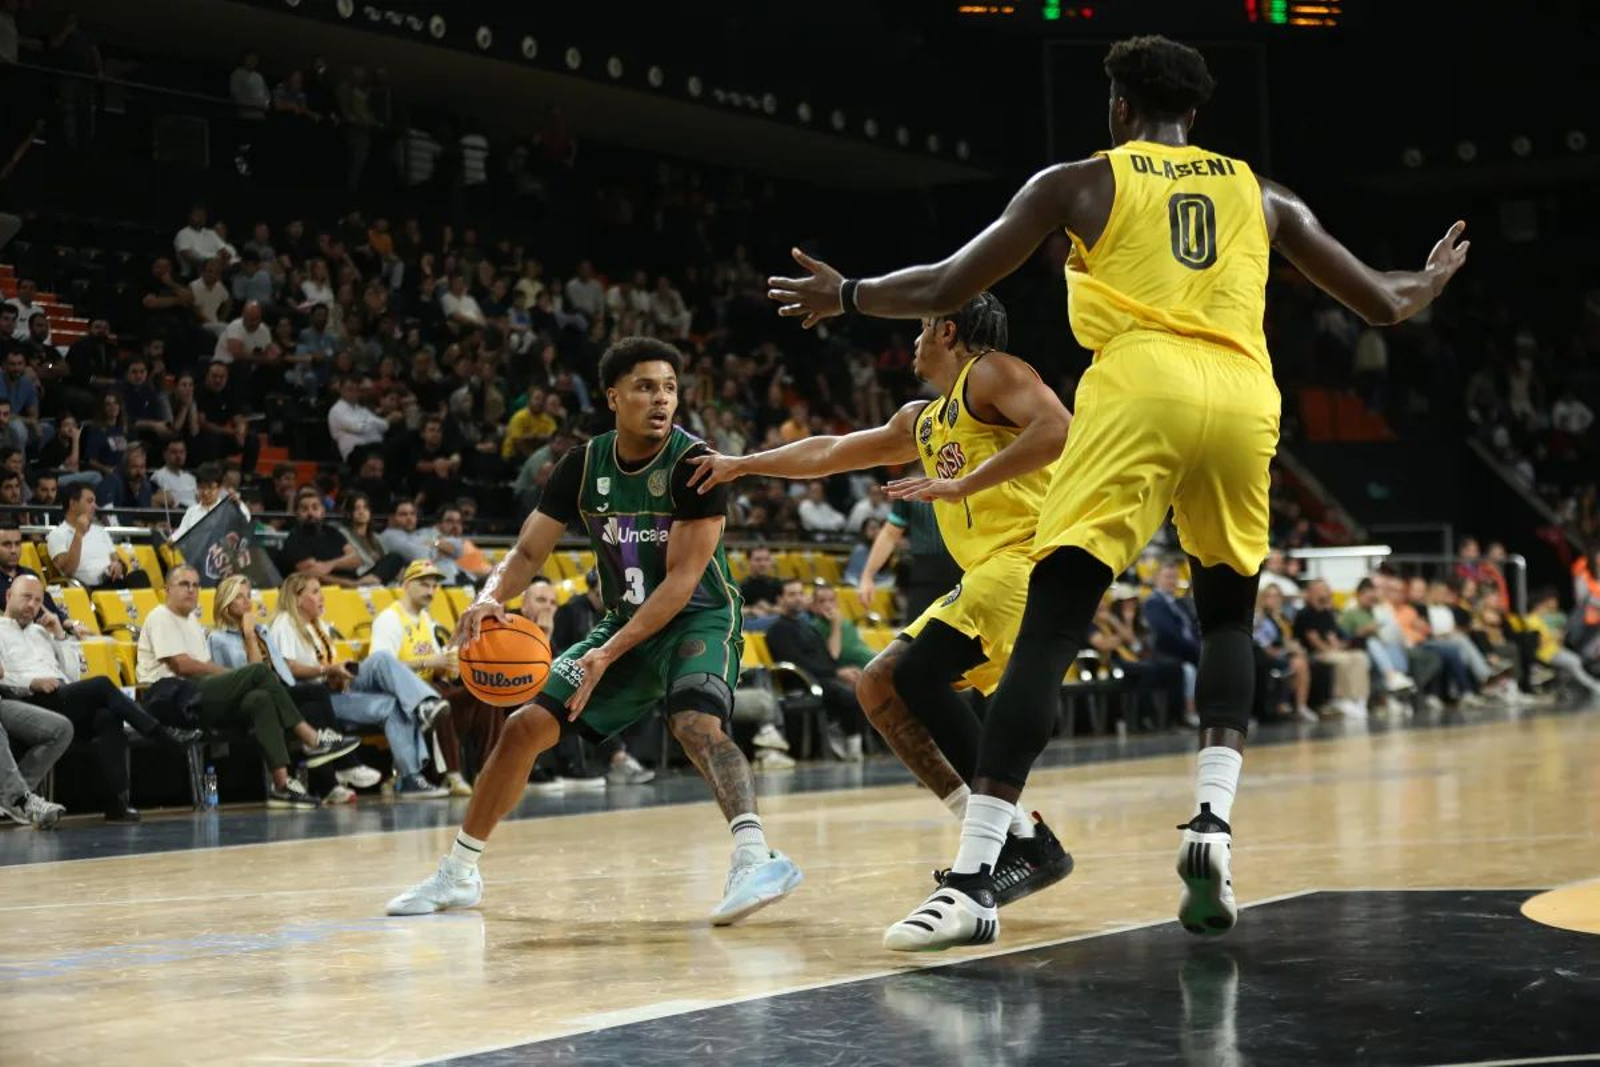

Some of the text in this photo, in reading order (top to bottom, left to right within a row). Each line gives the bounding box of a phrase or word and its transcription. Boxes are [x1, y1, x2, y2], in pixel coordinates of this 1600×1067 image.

[1130, 154, 1236, 181] OLASENI
[1168, 192, 1217, 271] 0
[618, 525, 669, 547] Uncaja
[622, 566, 646, 605] 3
[471, 668, 533, 687] Wilson
